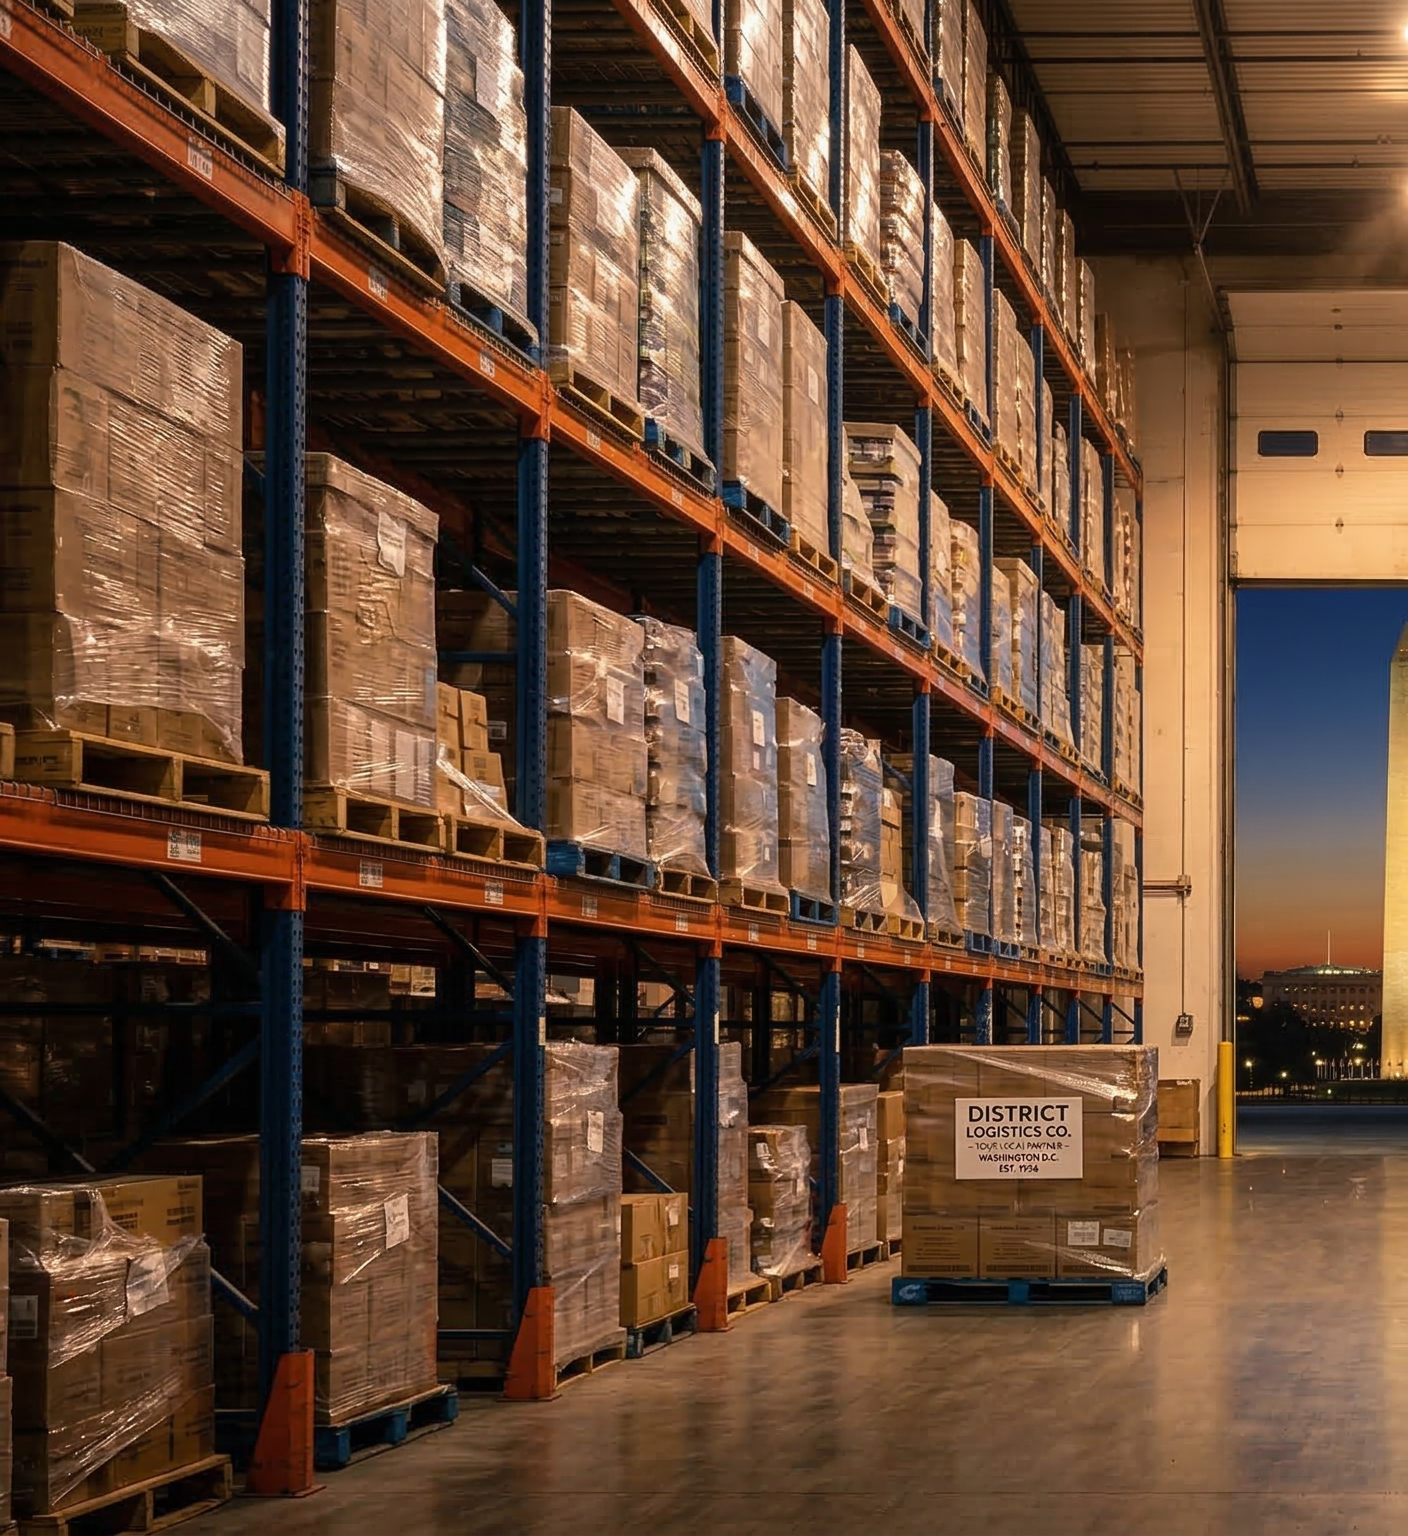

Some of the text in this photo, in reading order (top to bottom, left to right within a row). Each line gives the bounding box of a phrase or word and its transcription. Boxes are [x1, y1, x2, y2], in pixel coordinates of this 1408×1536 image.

[968, 1104, 1069, 1122] DISTRICT
[966, 1125, 1071, 1138] LOGISTICS CO.
[978, 1153, 1059, 1162] WASHINGTON D.C.
[999, 1164, 1016, 1173] EST.
